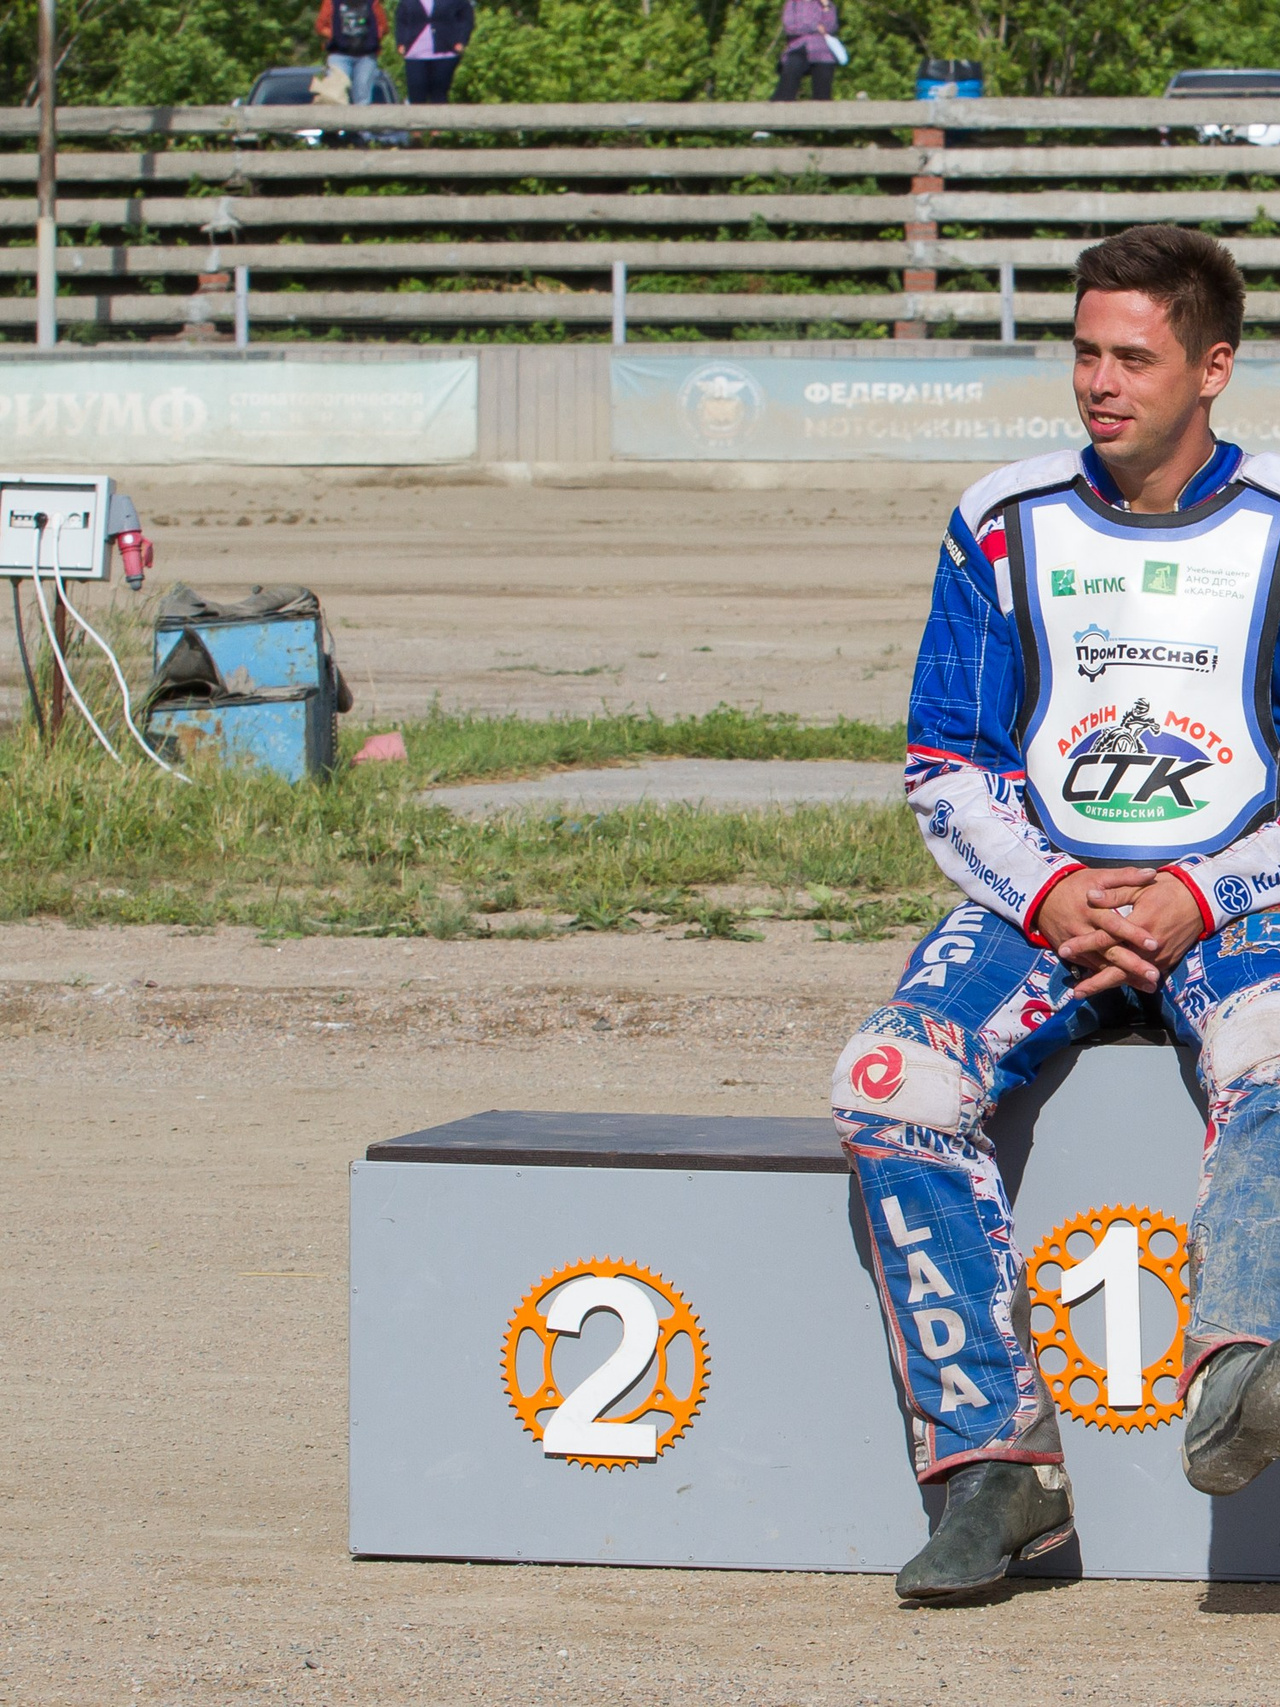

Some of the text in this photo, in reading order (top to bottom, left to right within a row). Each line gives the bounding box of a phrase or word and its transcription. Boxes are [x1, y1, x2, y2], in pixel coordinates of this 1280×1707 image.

[0, 387, 207, 442] ИУМФ
[804, 382, 983, 408] ФЕДЕРАЦИЯ
[1084, 577, 1126, 595] НГМС
[1186, 575, 1237, 587] АНО ДПО
[1225, 570, 1250, 578] центр
[1075, 644, 1209, 666] ПромТехСнаб
[1057, 705, 1233, 764] АЛТЫН МОТО
[1062, 753, 1216, 809] СТК
[1085, 804, 1165, 819] ОКТЯБРЬСКИЙ
[880, 1195, 989, 1413] LADA
[1061, 1226, 1143, 1407] 1
[543, 1276, 659, 1459] 2
